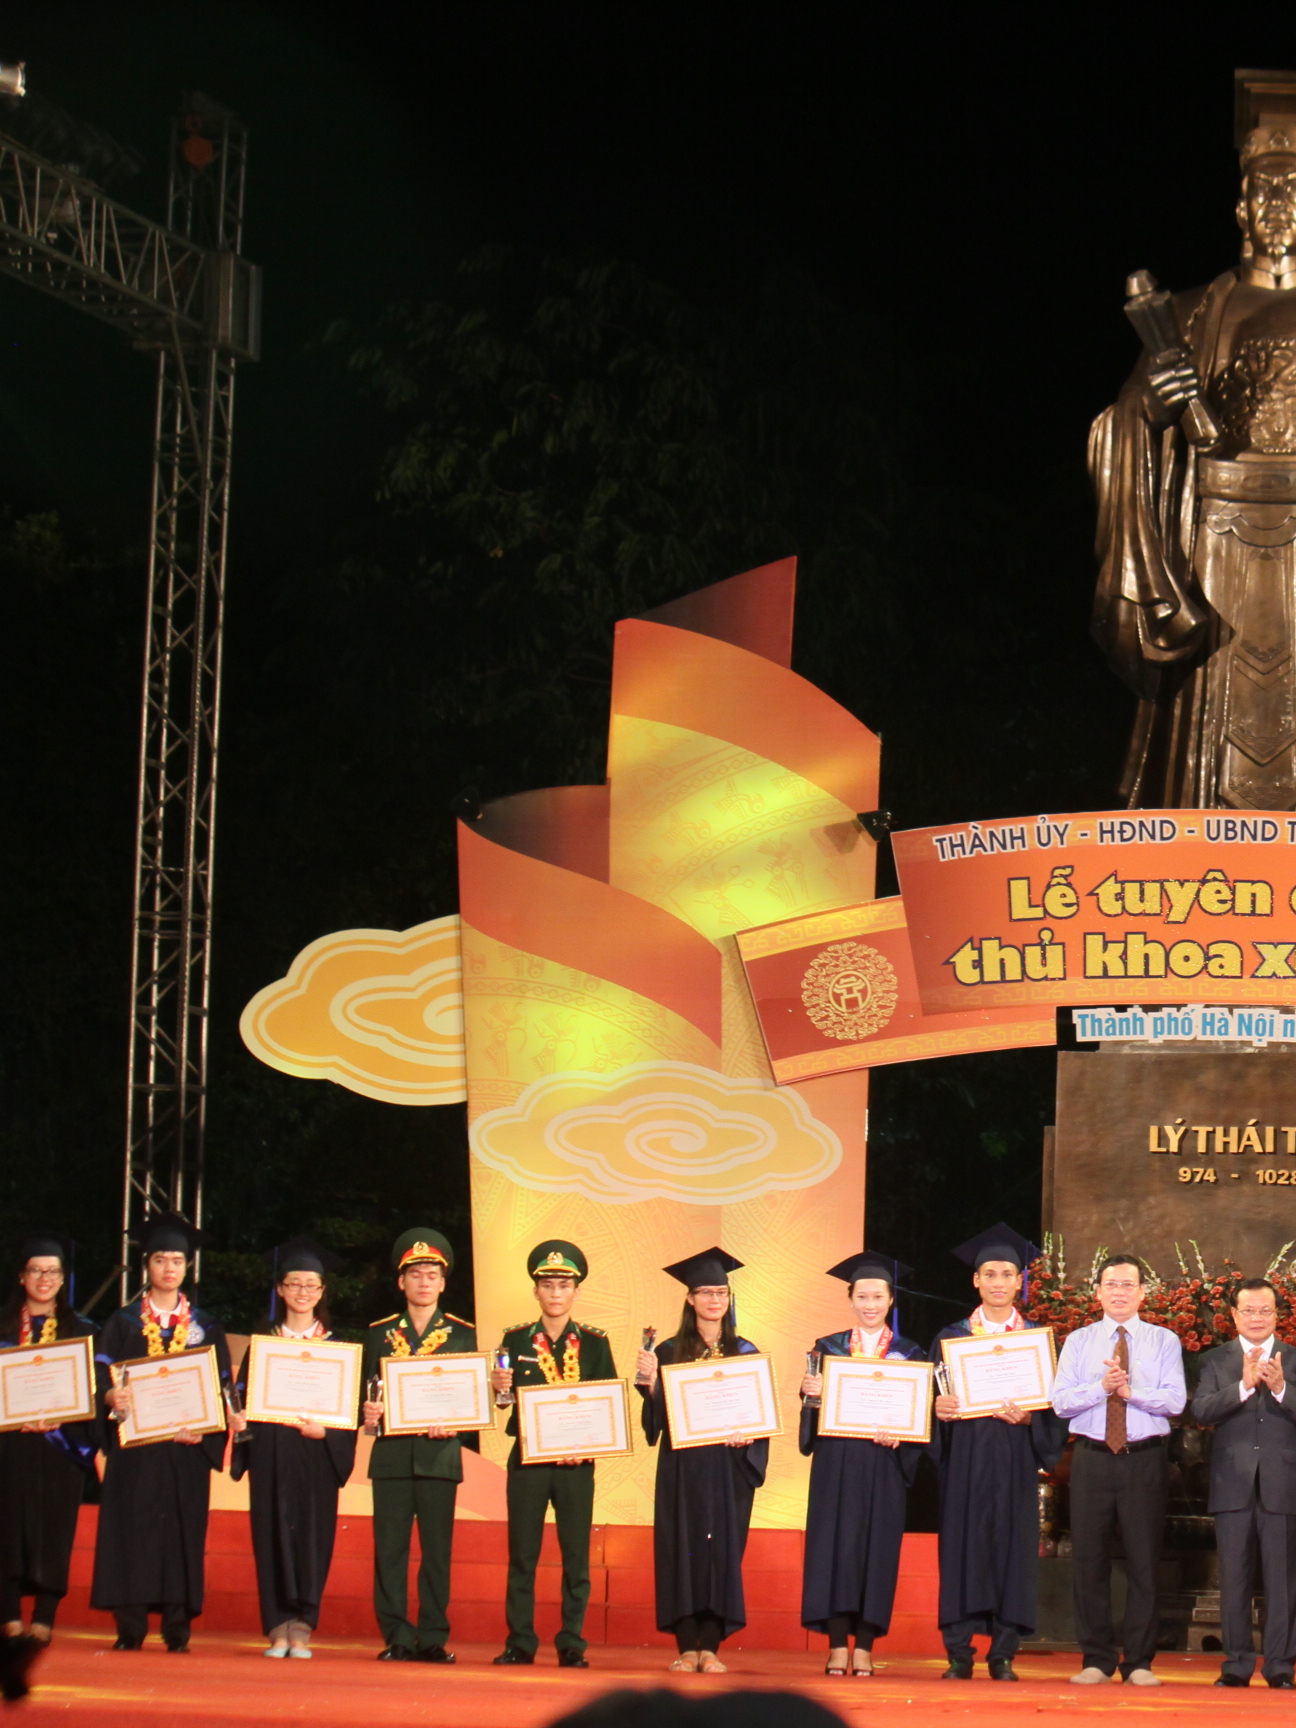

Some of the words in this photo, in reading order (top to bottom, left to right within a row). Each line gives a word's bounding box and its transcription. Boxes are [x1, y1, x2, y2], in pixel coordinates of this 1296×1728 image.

[935, 822, 1027, 861] THÀNH
[1036, 816, 1070, 847] ỦY
[1099, 819, 1177, 844] HĐND
[1206, 819, 1279, 843] UBND
[1007, 865, 1080, 922] Lễ
[1086, 869, 1274, 924] tuyên
[942, 927, 1067, 986] thủ
[1083, 932, 1243, 979] khoa
[1077, 1012, 1145, 1038] Thành
[1153, 1007, 1193, 1039] phố
[1201, 1011, 1230, 1037] Hà
[1238, 1012, 1275, 1043] Nội
[1150, 1118, 1187, 1153] LÝ
[1192, 1119, 1276, 1155] THÁI
[1178, 1167, 1217, 1184] 974
